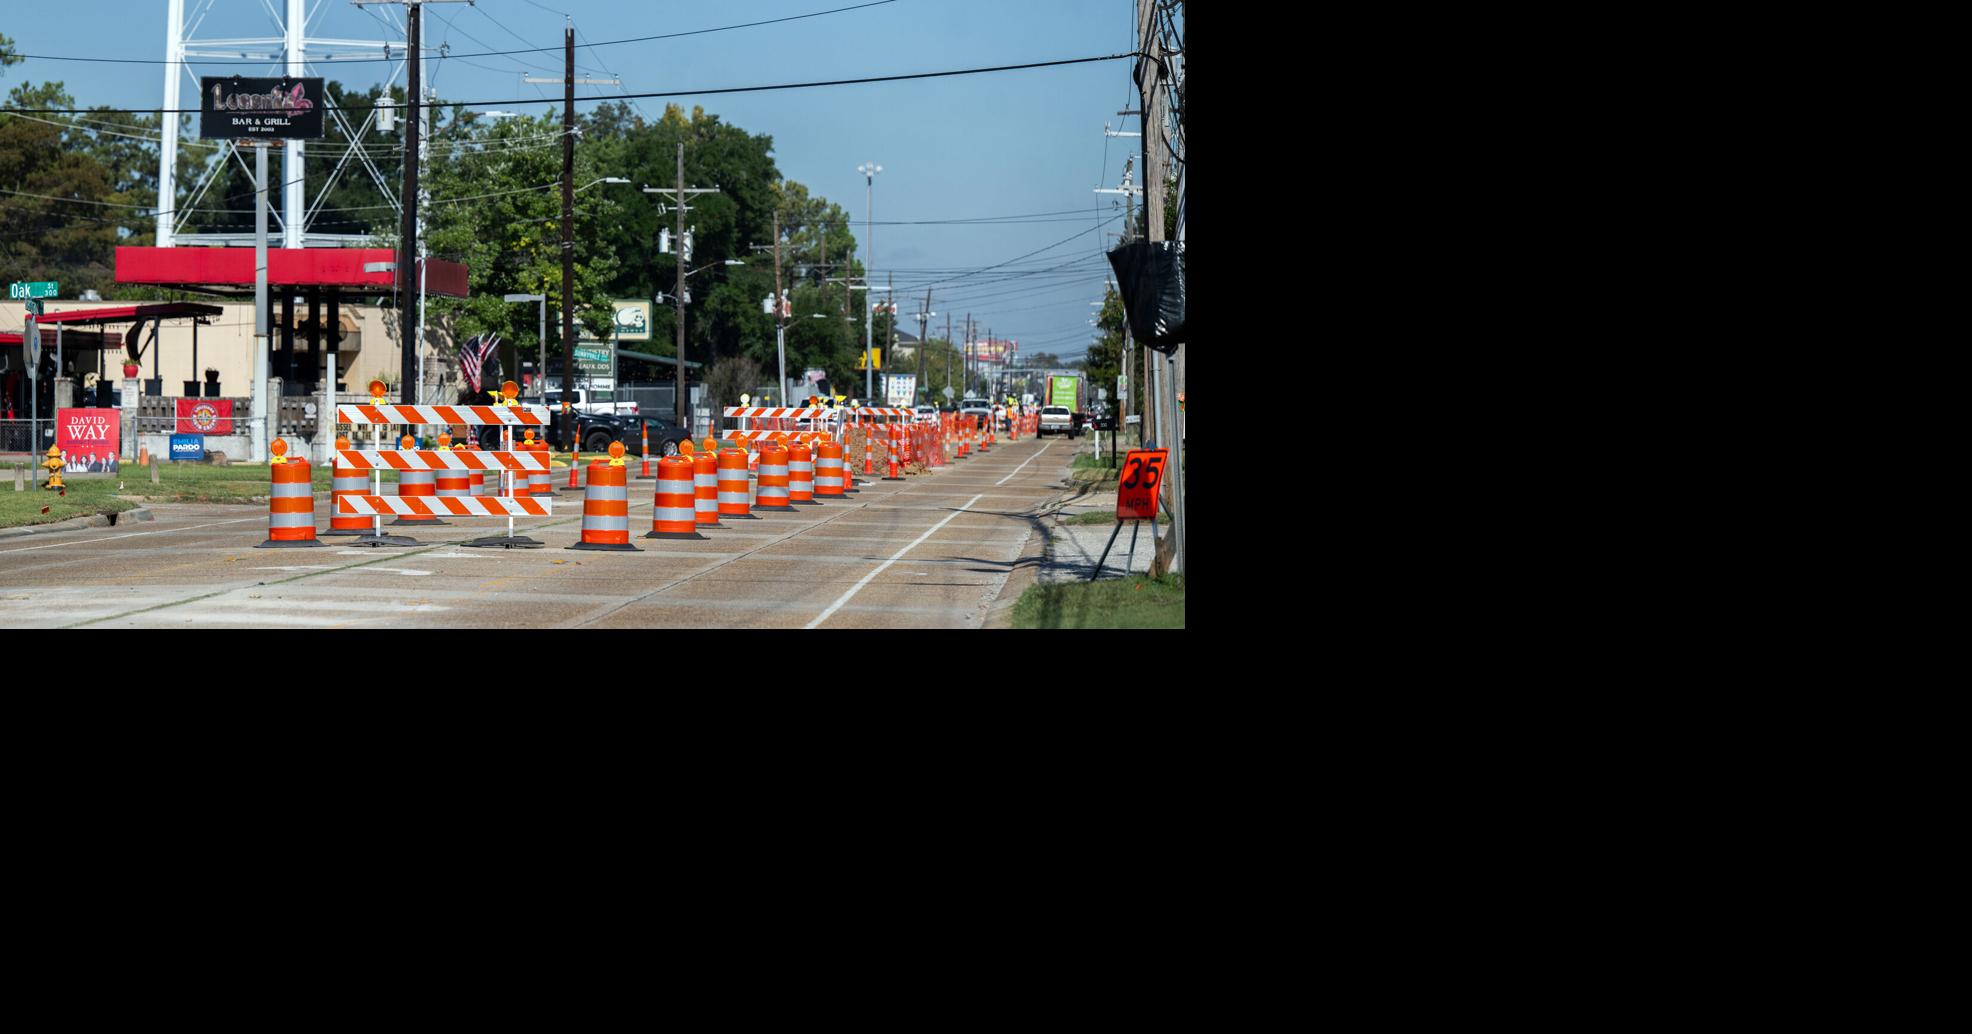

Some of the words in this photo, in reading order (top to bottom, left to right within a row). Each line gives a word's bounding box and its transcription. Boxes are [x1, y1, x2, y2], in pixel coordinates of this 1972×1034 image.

[264, 118, 291, 126] GRILL
[11, 283, 31, 298] Oak
[47, 282, 54, 290] St
[71, 416, 105, 424] DAVID
[66, 424, 110, 440] WAY
[1123, 457, 1162, 489] 35
[1126, 497, 1148, 510] MPH
